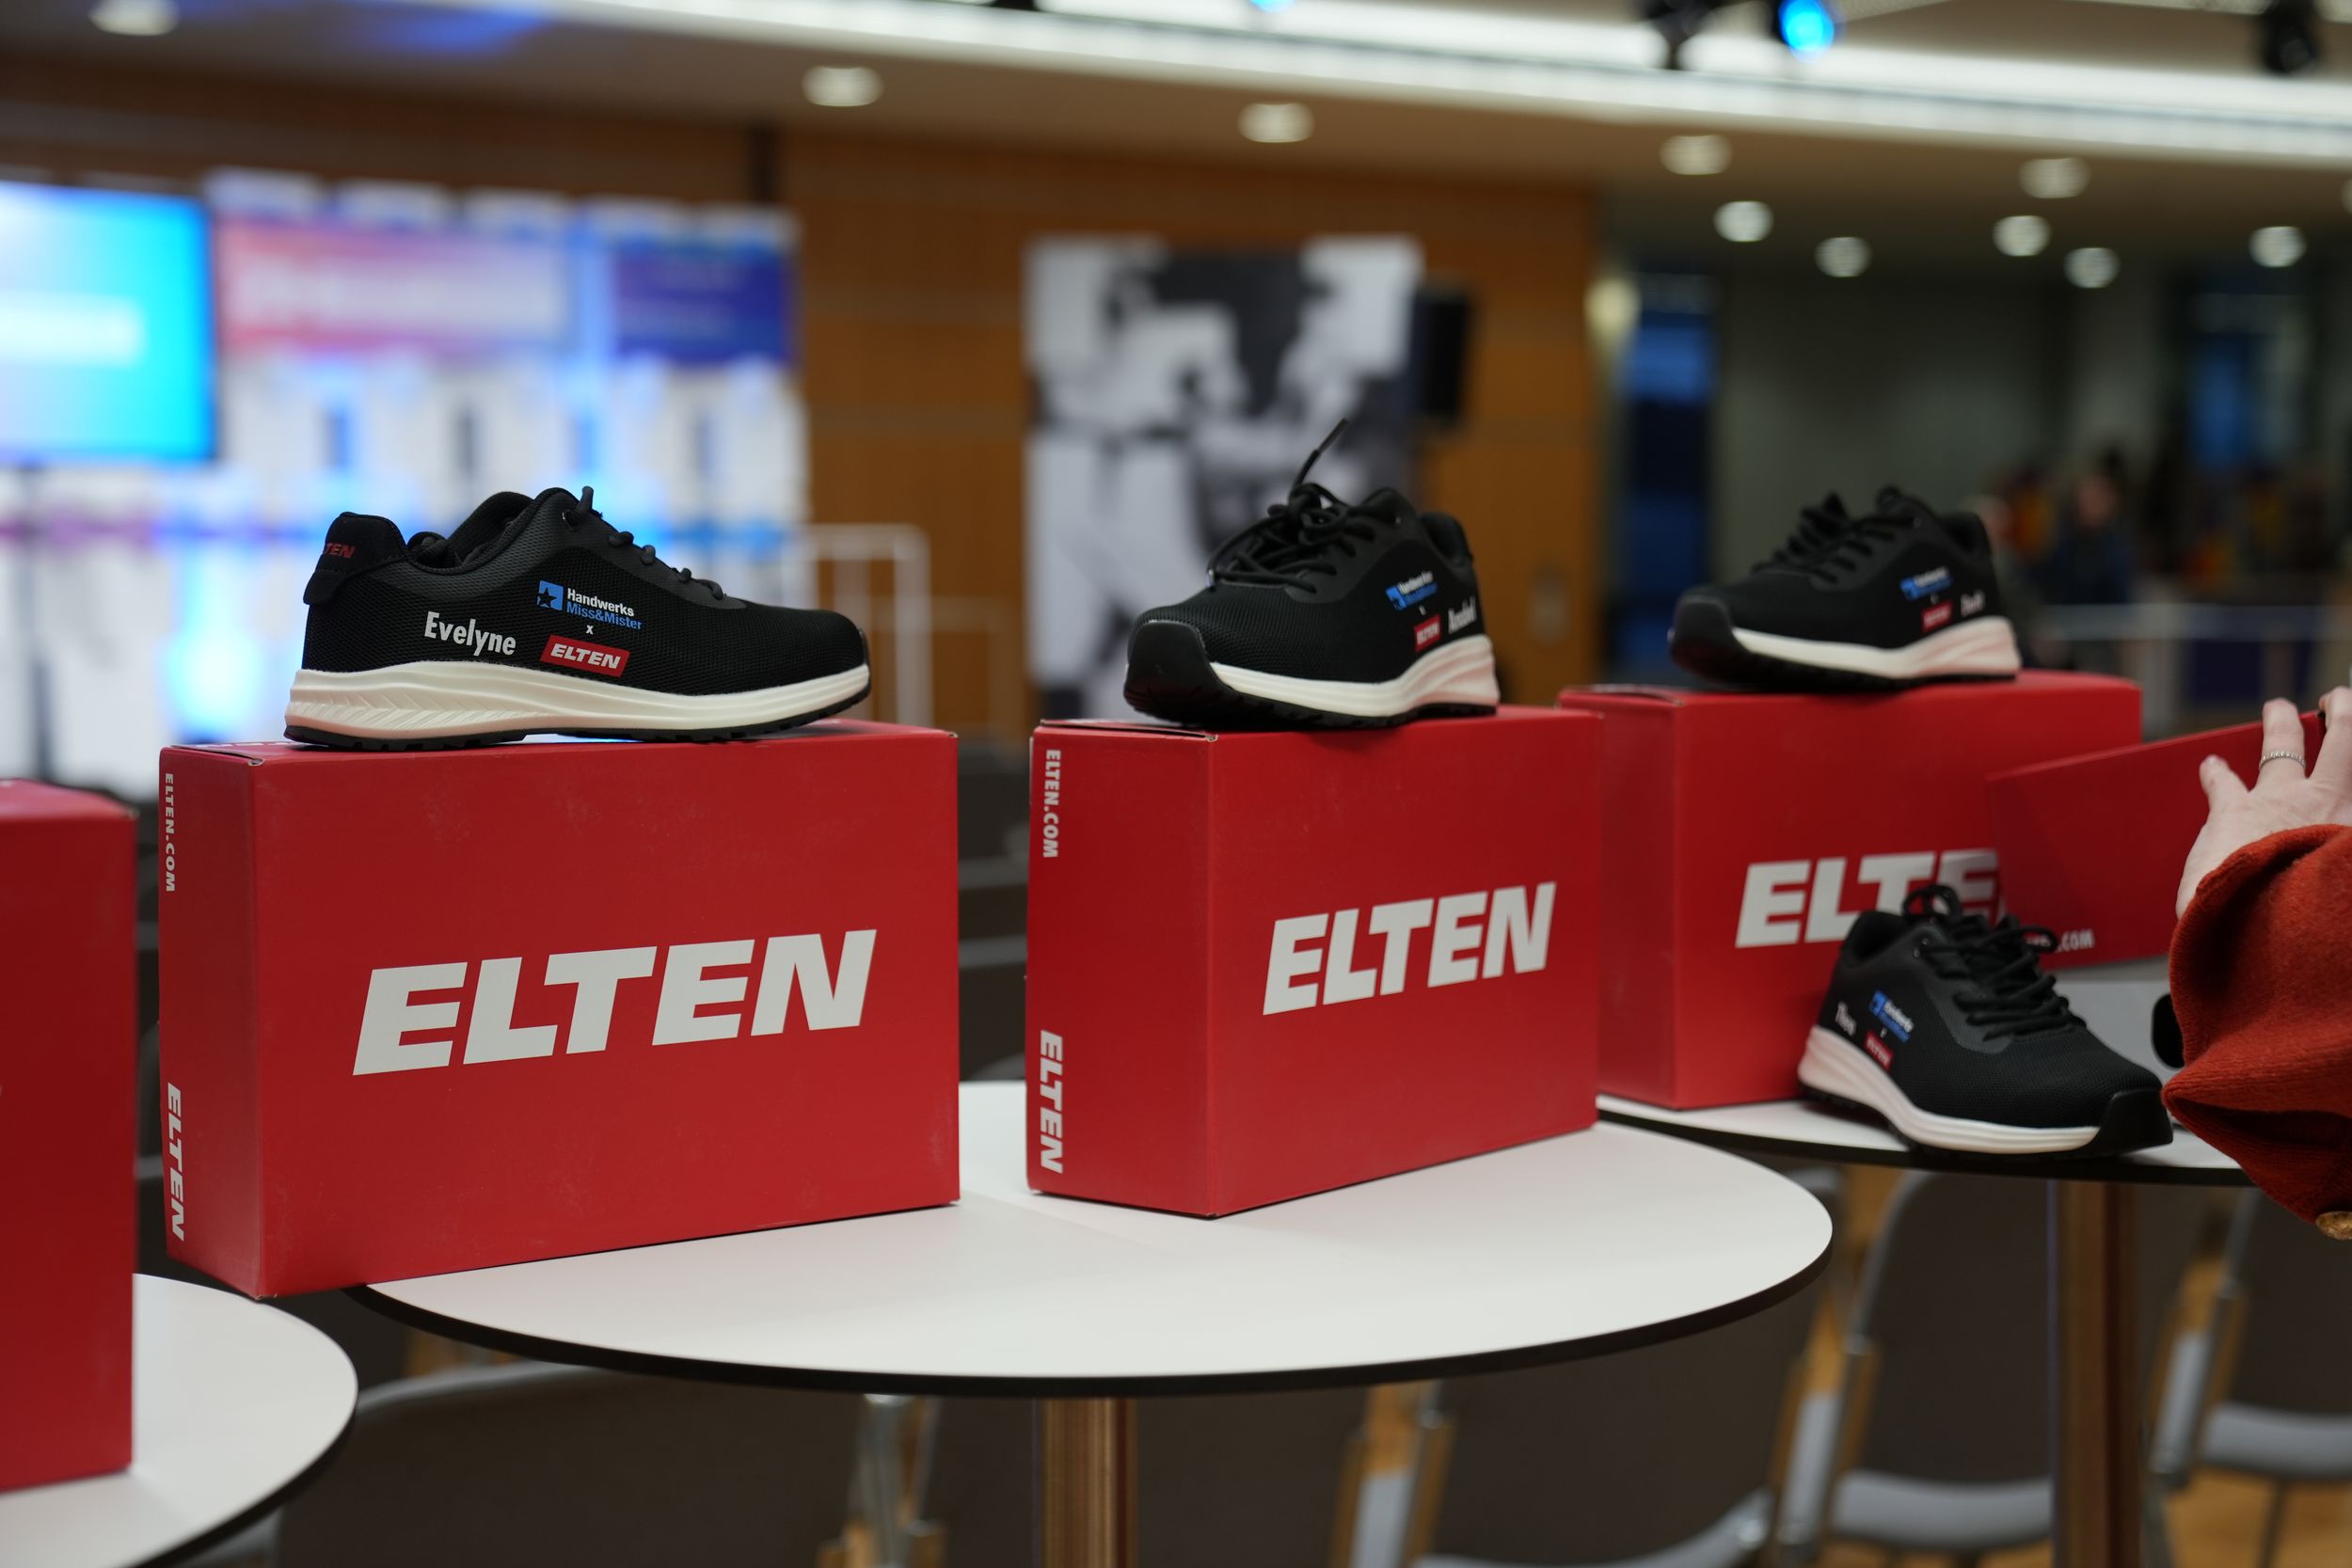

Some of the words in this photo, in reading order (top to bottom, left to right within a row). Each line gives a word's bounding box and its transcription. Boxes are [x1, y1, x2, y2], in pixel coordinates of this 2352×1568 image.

[424, 610, 516, 657] Evelyne
[550, 642, 622, 669] ELTEN
[566, 601, 644, 630] Miss&Mister
[567, 588, 635, 617] Handwerks
[165, 772, 176, 892] ELTEN.COM
[1042, 749, 1061, 858] ELTEN.COM
[1263, 881, 1557, 1016] ELTEN
[1735, 847, 2002, 948] ELTE
[353, 929, 878, 1076] ELTEN
[1040, 1029, 1064, 1175] ELTEN
[167, 1082, 185, 1242] ELTEN
